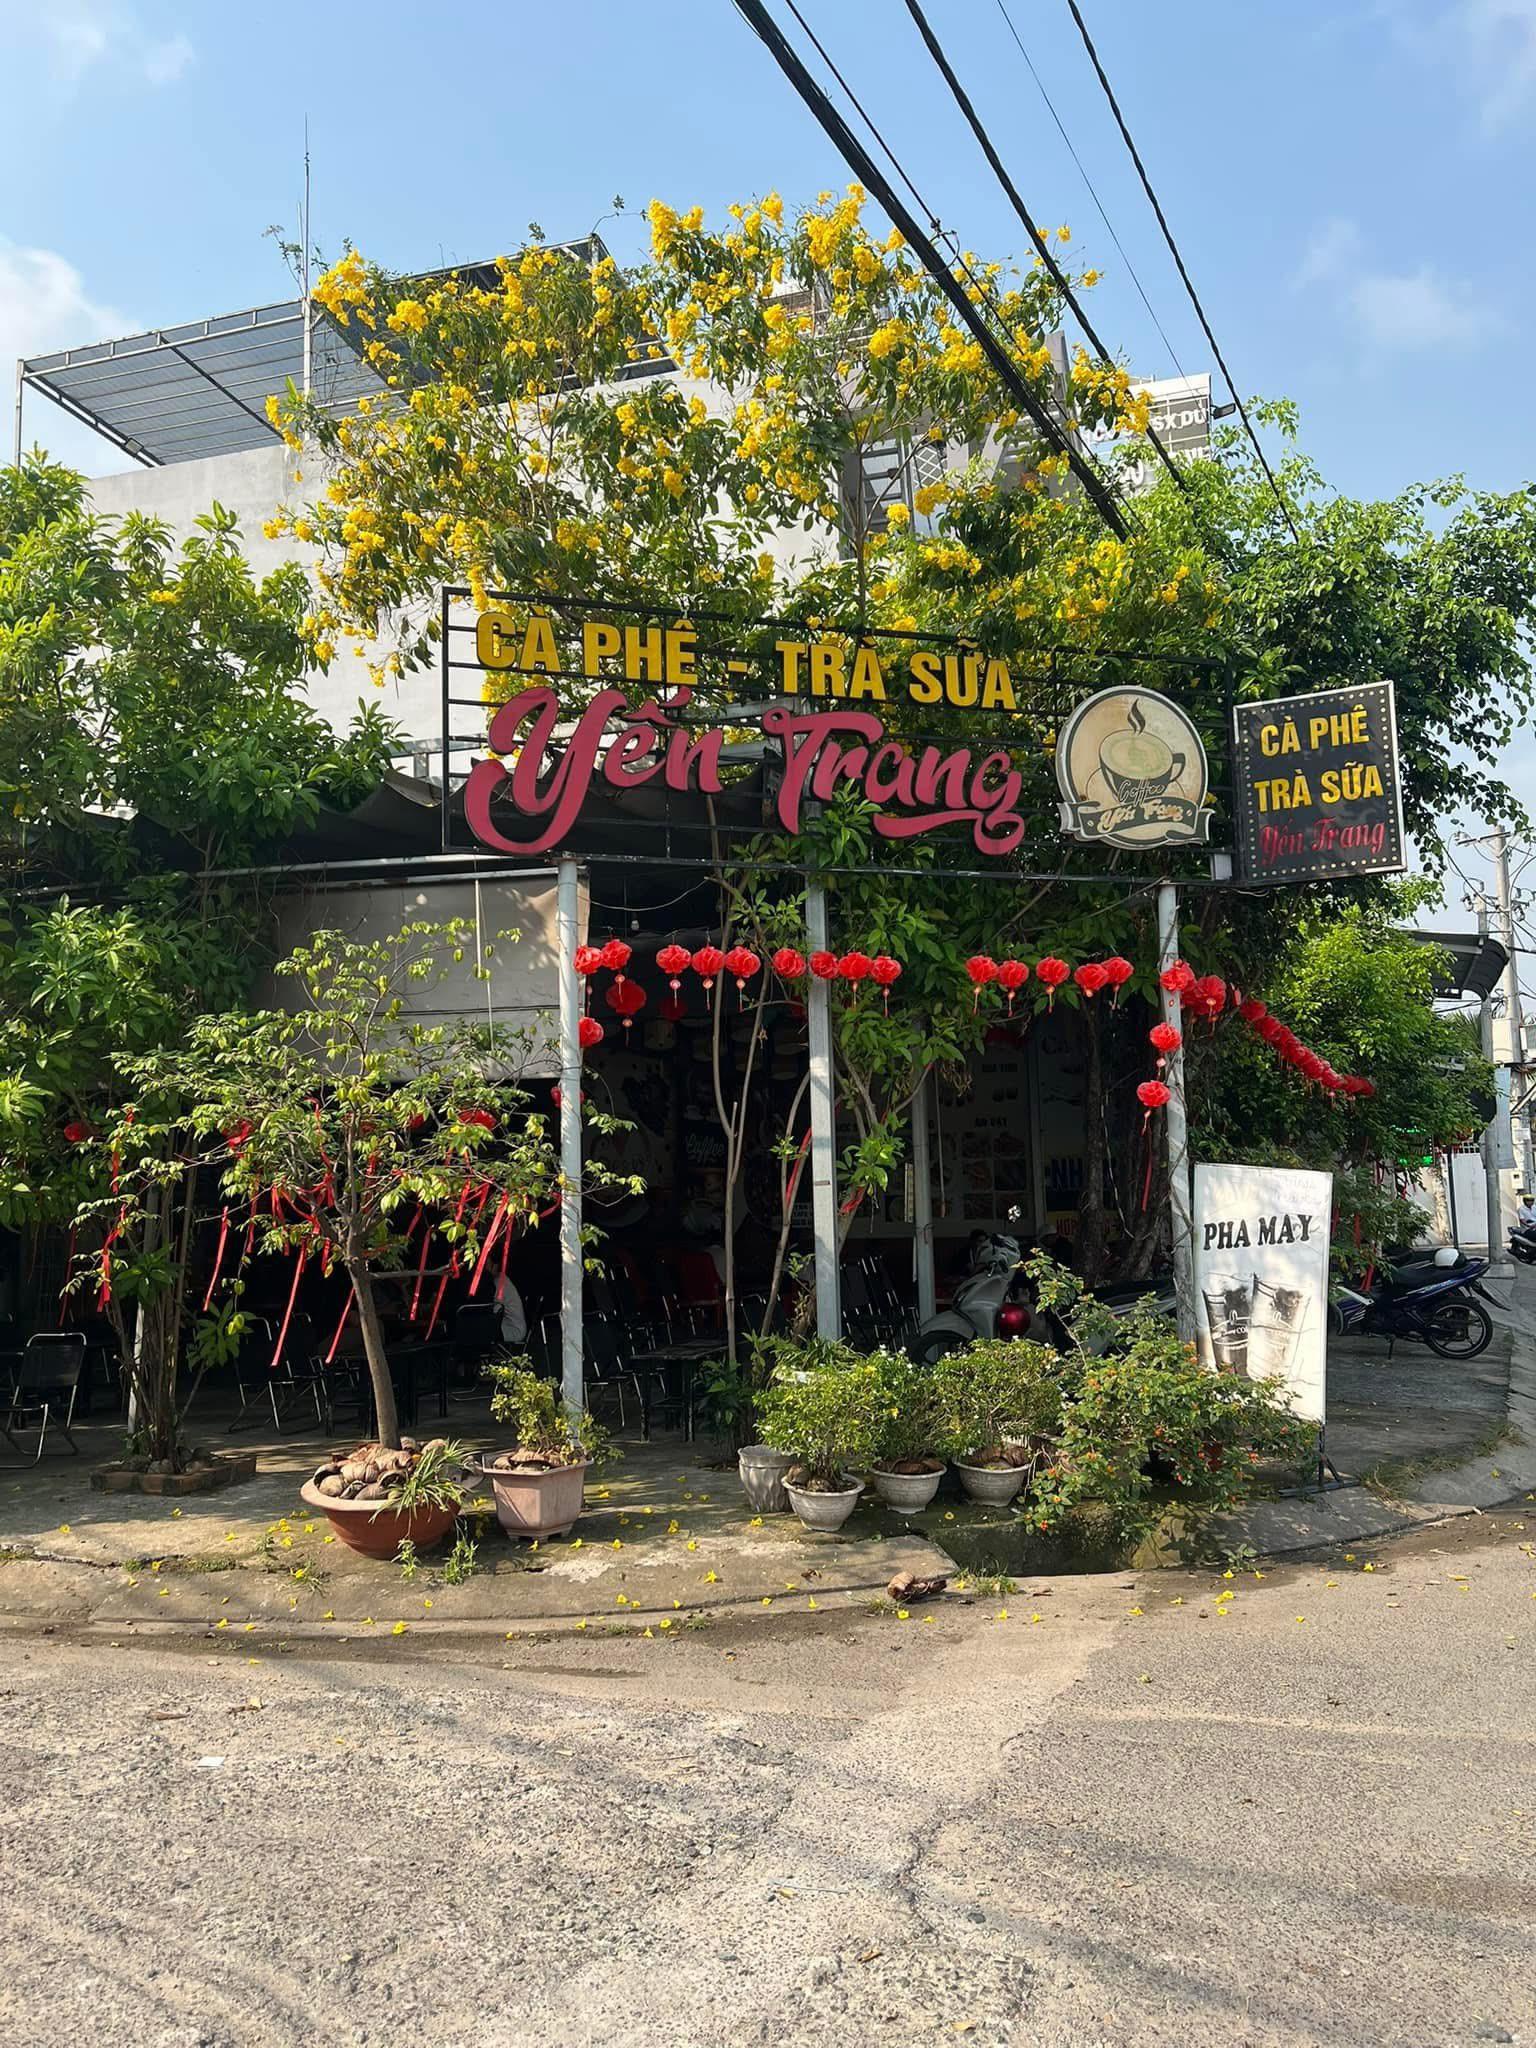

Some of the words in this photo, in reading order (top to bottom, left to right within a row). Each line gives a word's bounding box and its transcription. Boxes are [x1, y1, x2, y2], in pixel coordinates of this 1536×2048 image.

[476, 606, 562, 675] CÀ
[582, 618, 699, 687] PHÊ
[775, 636, 886, 702] TRÀ
[909, 640, 1017, 711] SỮA
[1261, 715, 1301, 757] CÀ
[1309, 704, 1370, 750] PHÊ
[465, 686, 724, 857] Yến
[761, 707, 1026, 856] Trang
[1254, 769, 1312, 812] TRÀ
[1320, 761, 1384, 804] SỮA
[1311, 817, 1385, 854] Trang
[1203, 1219, 1251, 1251] PHA
[1258, 1214, 1312, 1246] MAY
